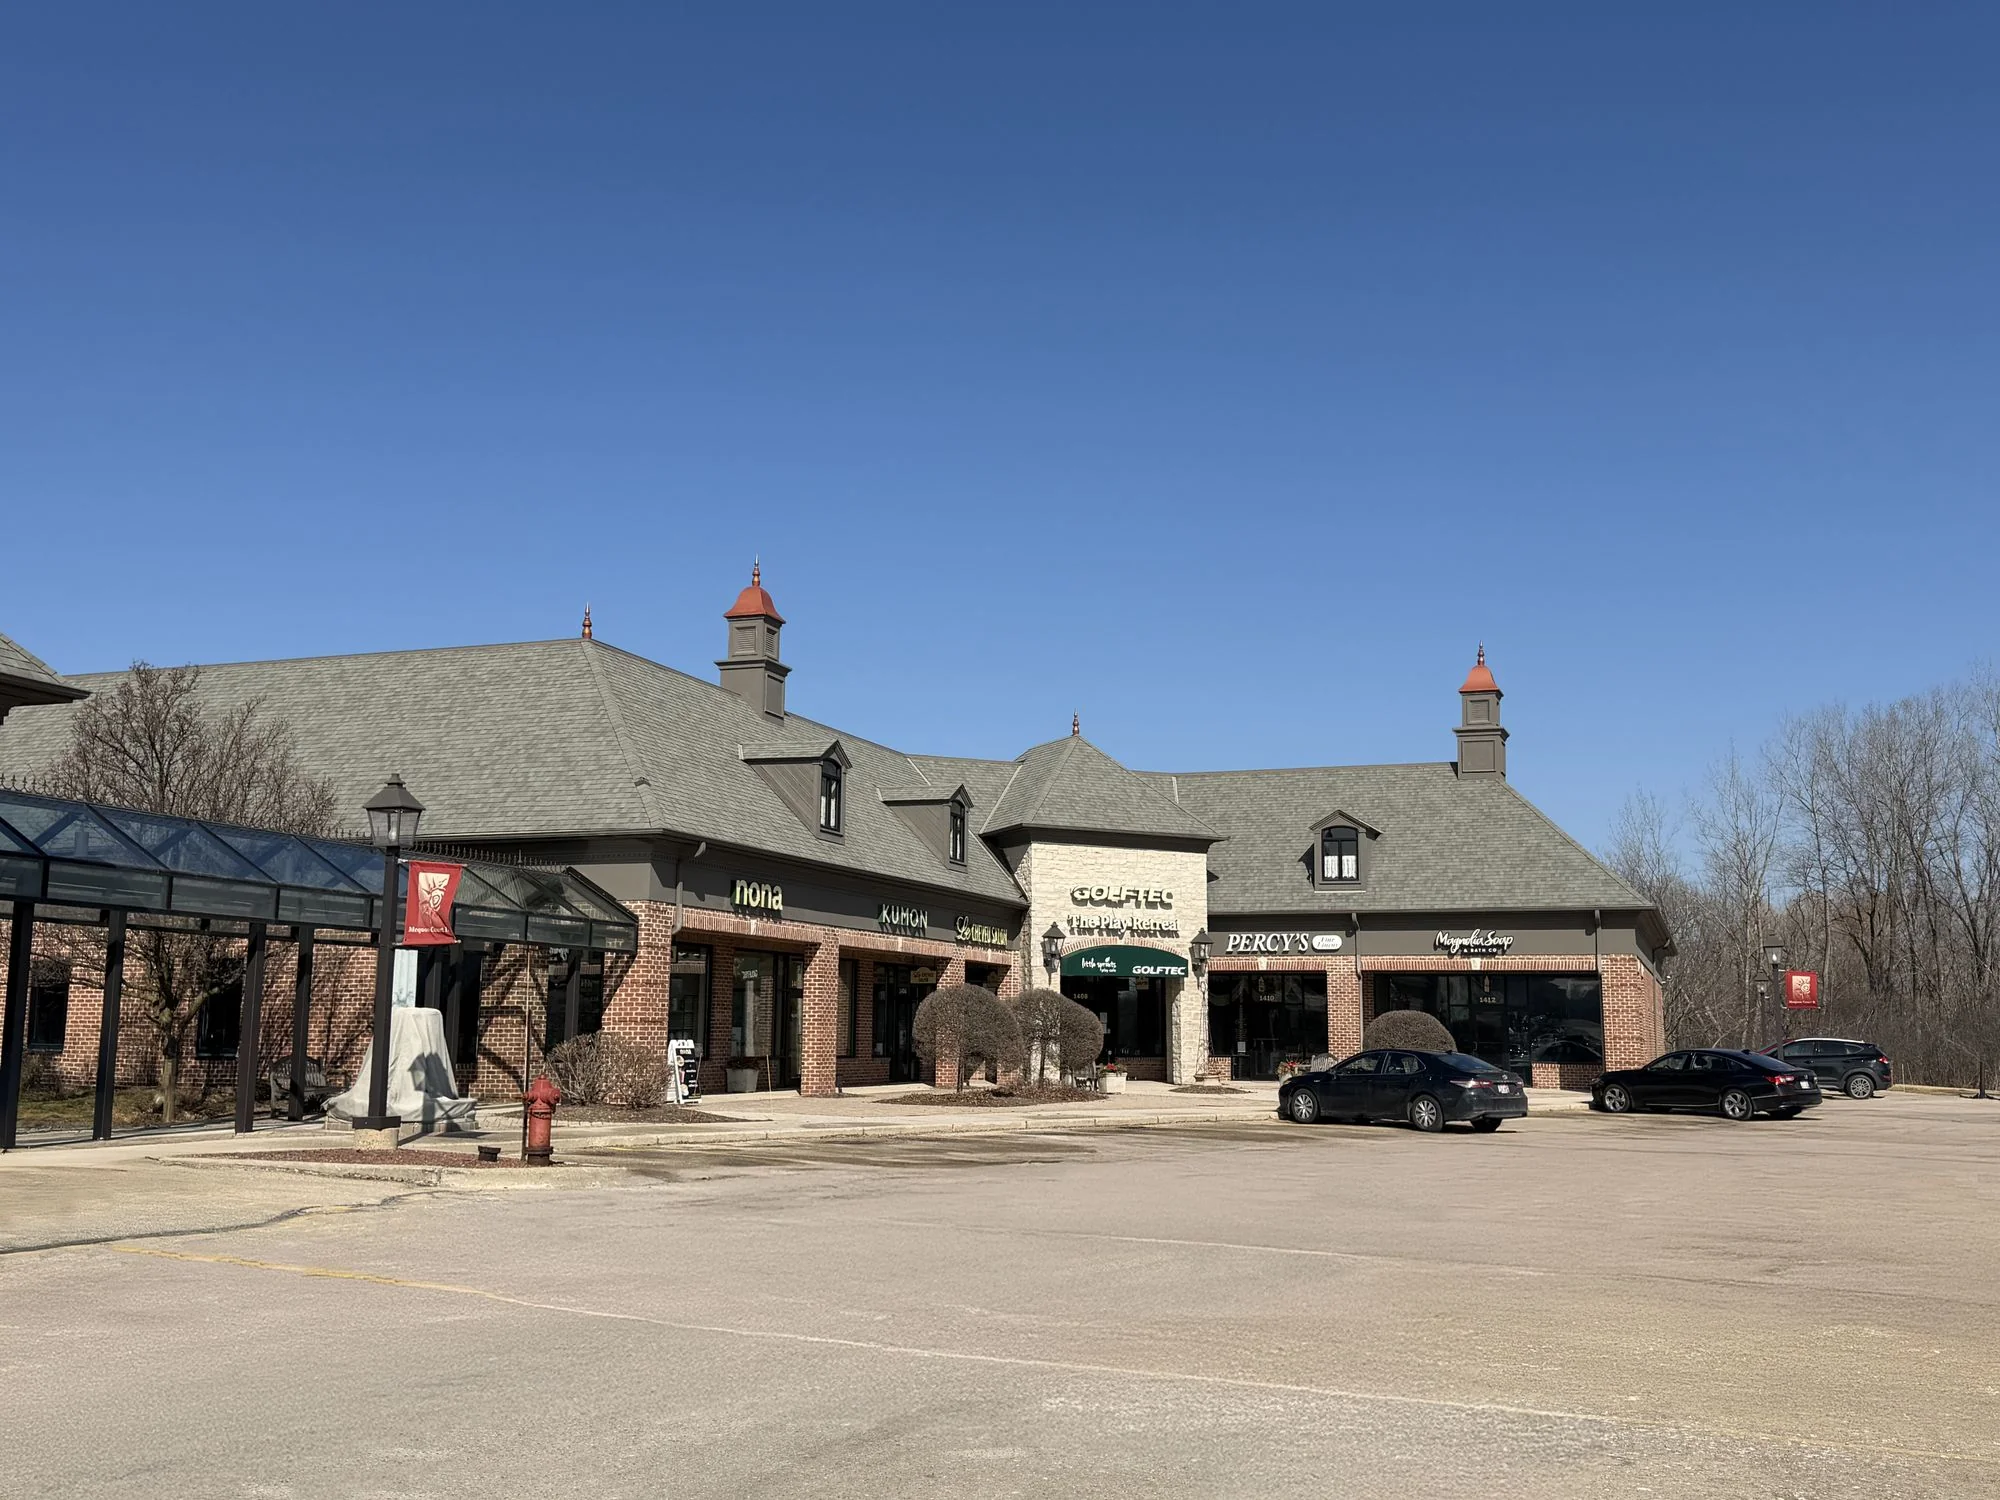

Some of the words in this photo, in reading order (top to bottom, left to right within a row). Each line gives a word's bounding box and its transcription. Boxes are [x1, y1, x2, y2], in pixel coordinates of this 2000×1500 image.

[735, 879, 783, 910] nona
[1072, 885, 1174, 903] GOLFTEC
[882, 903, 928, 929] KUMON
[1069, 914, 1100, 929] The
[1100, 914, 1131, 935] Play
[1226, 933, 1309, 952] PERCY'S
[1435, 928, 1484, 954] Magnolia
[1484, 930, 1513, 950] Soap
[1132, 965, 1186, 976] GOLFTEC
